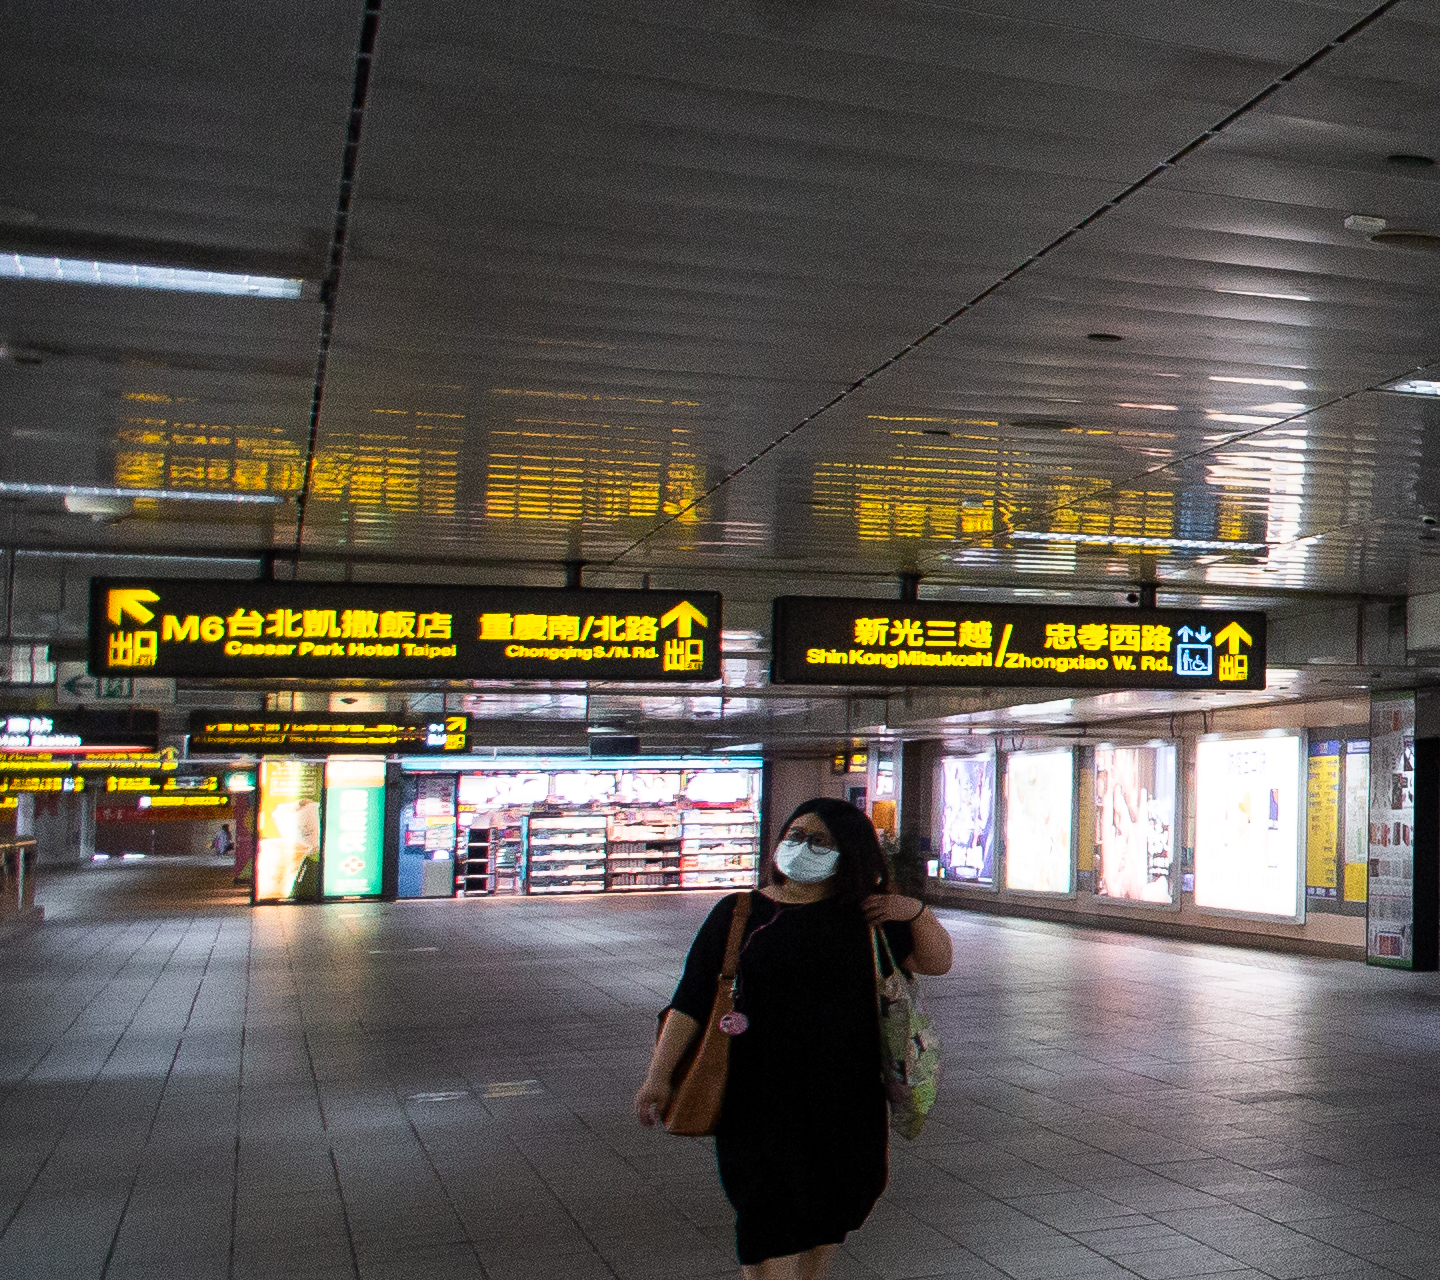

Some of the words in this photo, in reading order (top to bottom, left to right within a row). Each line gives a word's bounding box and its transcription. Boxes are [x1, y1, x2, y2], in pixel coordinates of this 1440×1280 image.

[854, 618, 992, 648] 新光三越
[1044, 622, 1173, 652] 忠孝西路
[108, 630, 158, 668] 出口
[224, 641, 297, 657] Caesar
[299, 641, 345, 657] Park
[347, 642, 400, 658] Hotel
[402, 643, 457, 659] Taipei
[504, 645, 592, 661] Chongqing
[632, 646, 660, 659] Rd.
[664, 638, 704, 671] 出口
[806, 648, 848, 664] Shin
[849, 649, 899, 668] Kong
[899, 650, 992, 667] Mitsukoshi
[1005, 653, 1109, 673] Zhongxiao
[1112, 654, 1137, 670] W.
[1141, 654, 1173, 671] Rd.
[1218, 654, 1248, 681] 出口
